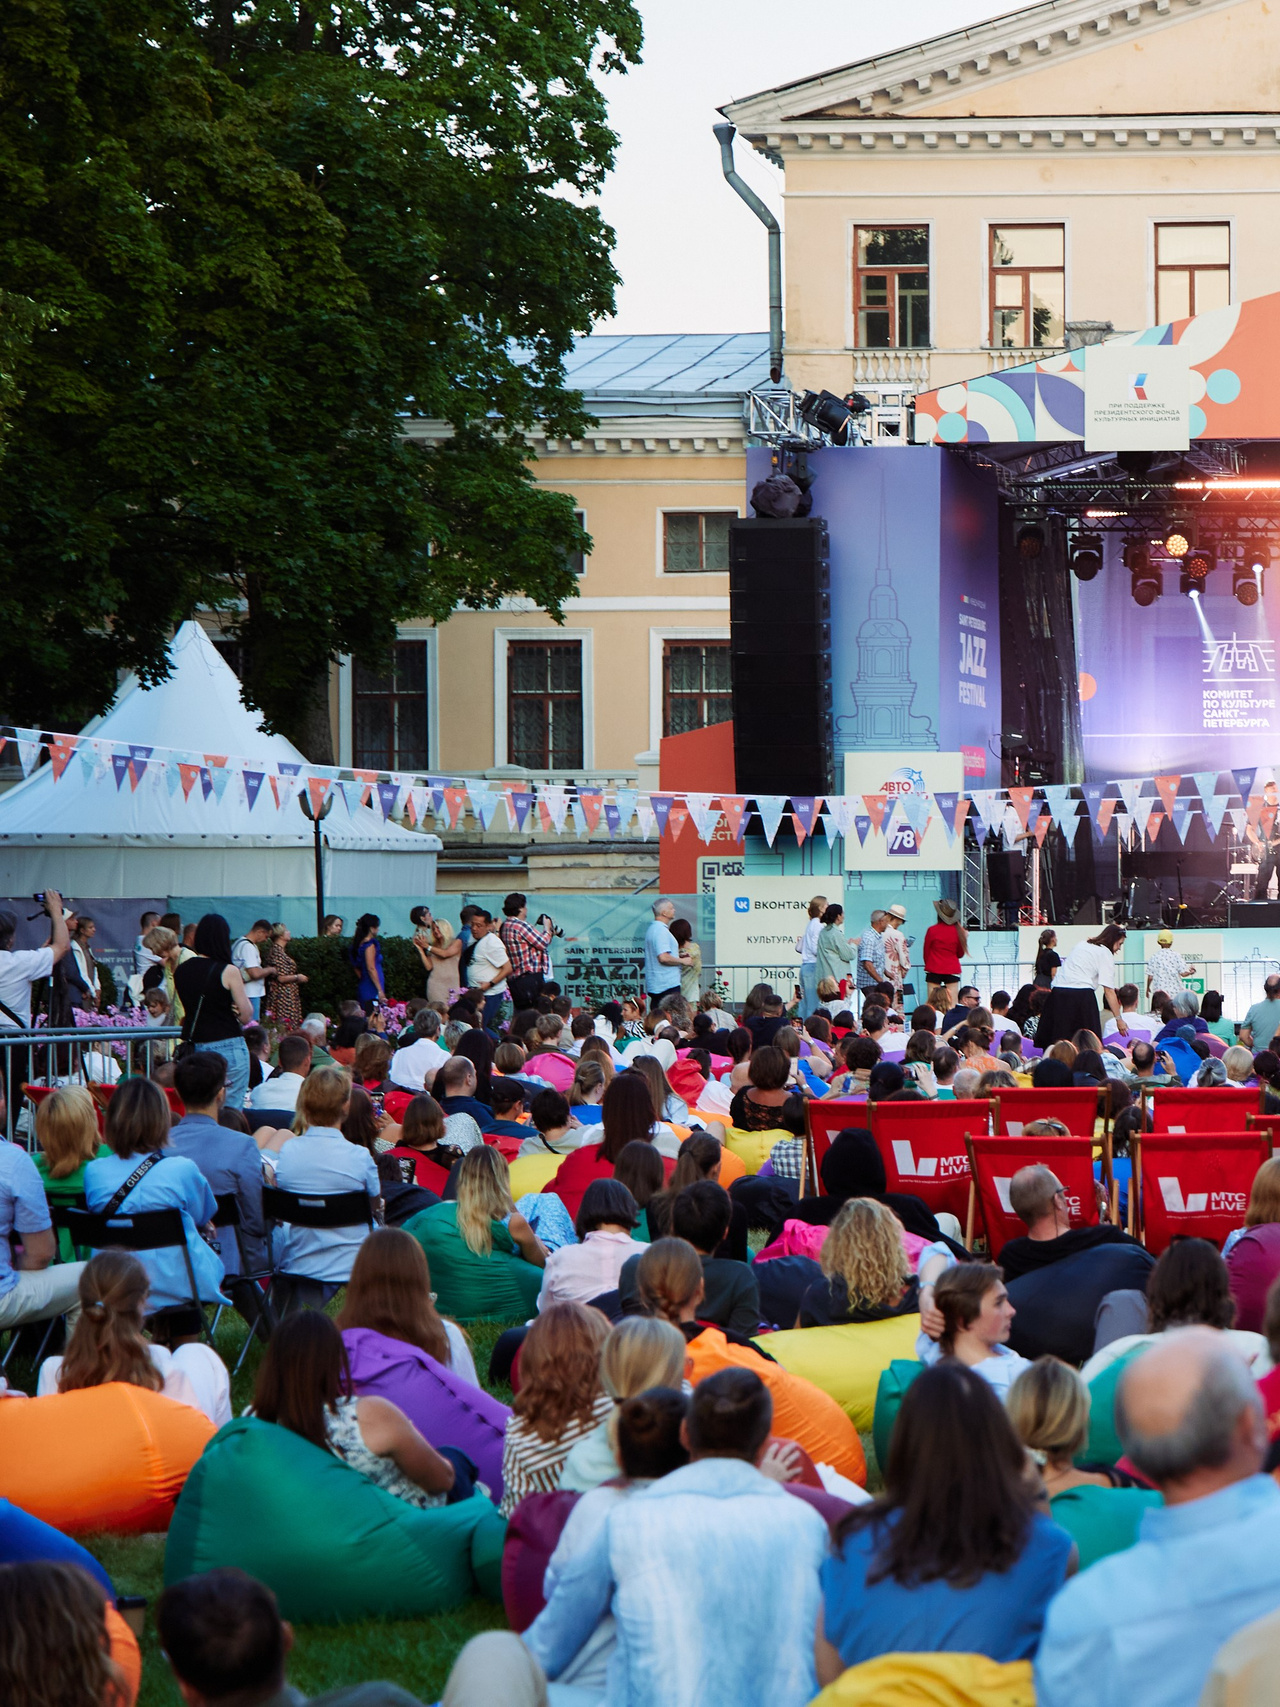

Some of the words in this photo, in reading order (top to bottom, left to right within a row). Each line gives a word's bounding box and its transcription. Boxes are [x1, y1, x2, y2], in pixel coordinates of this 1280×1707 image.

[959, 631, 987, 679] JAZZ
[1202, 689, 1254, 699] КОМИТЕТ
[1202, 699, 1219, 709] ПО
[1221, 699, 1276, 709] КУЛЬТУРЕ
[1203, 718, 1271, 728] ПЕТЕРБУРГА
[879, 781, 912, 792] АВТО
[892, 829, 916, 851] 78
[564, 947, 589, 955] SAINT
[591, 947, 646, 955] PETERSBUR
[126, 1159, 153, 1188] GUESS
[940, 1164, 972, 1177] LIVE
[1210, 1201, 1247, 1211] LIVE
